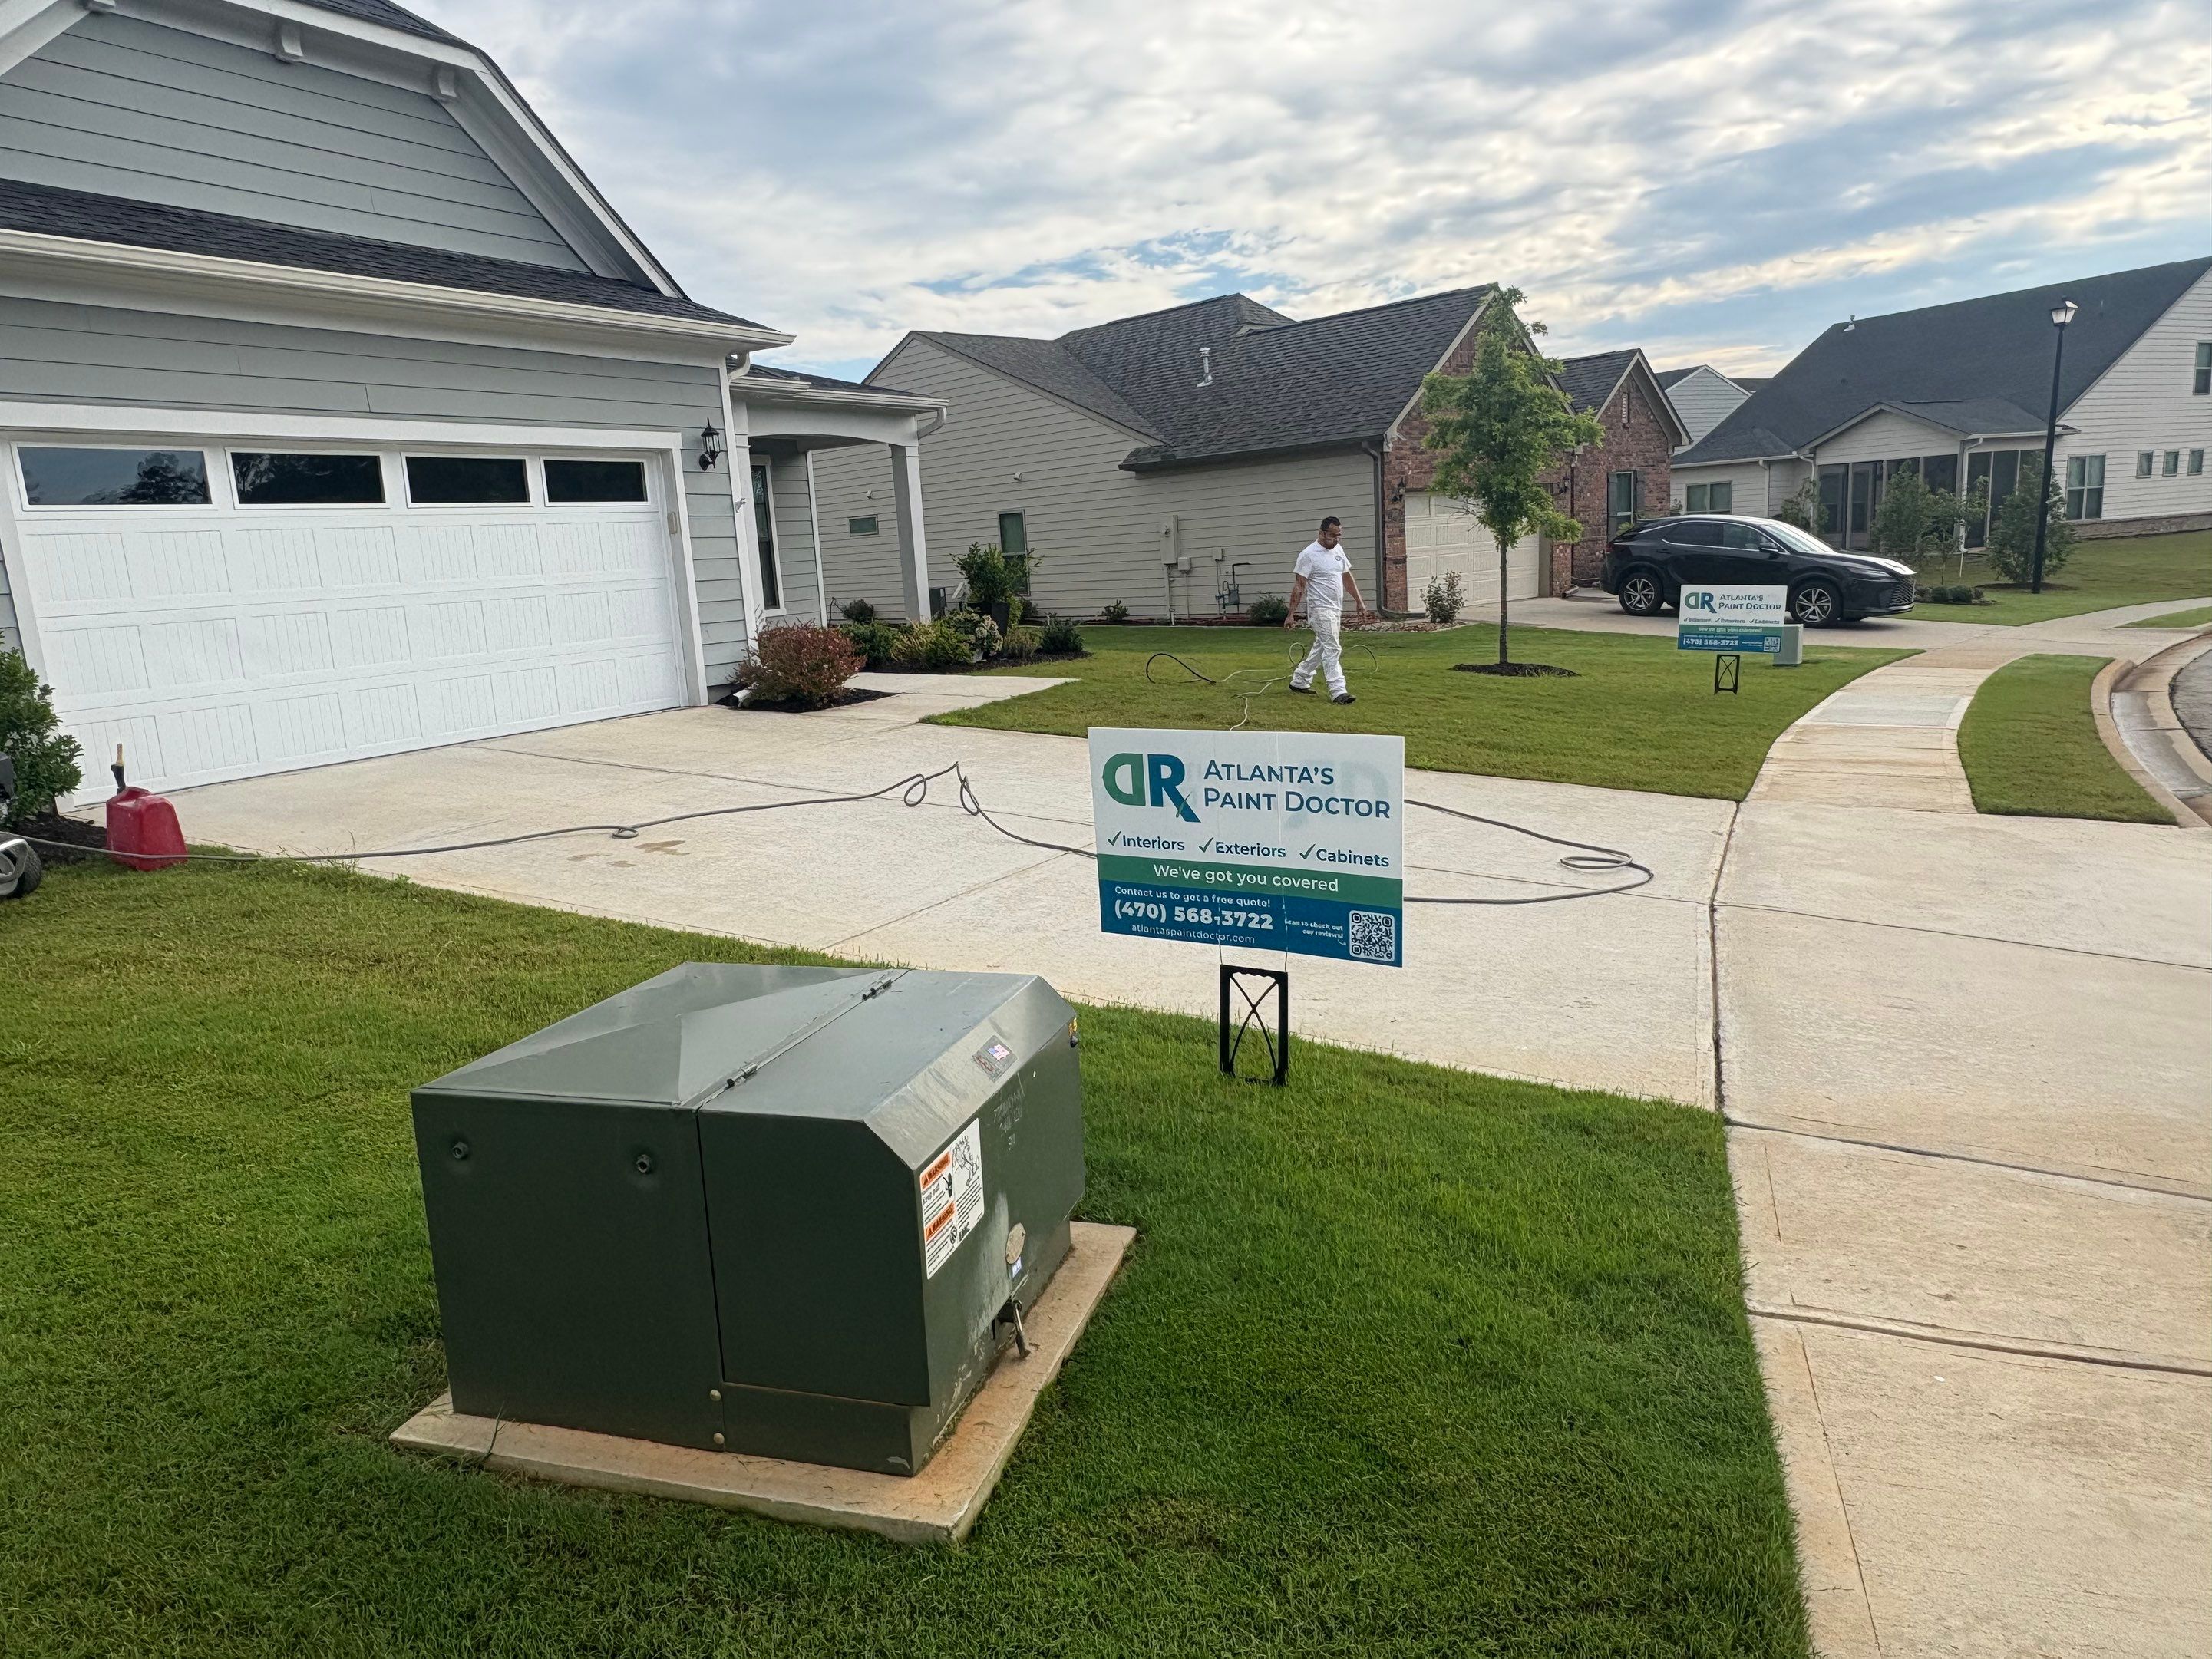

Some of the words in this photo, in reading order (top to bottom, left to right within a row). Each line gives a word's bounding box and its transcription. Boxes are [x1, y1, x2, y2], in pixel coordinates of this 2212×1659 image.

[1203, 760, 1334, 785] ATLANTA'S
[1204, 787, 1276, 810] PAINT
[1285, 790, 1390, 819] DOCTOR
[1123, 835, 1185, 851] Interiors
[1216, 841, 1286, 857] Exteriors
[1316, 848, 1389, 867] Cabinets
[1153, 864, 1200, 880] We've
[1205, 870, 1233, 883] got
[1236, 872, 1267, 886] you
[1272, 876, 1339, 892] covered
[1114, 886, 1153, 897] Contact
[1170, 891, 1180, 900] to
[1183, 894, 1200, 902] get
[1211, 894, 1234, 904] free
[1236, 897, 1271, 909] quote!
[1114, 899, 1167, 923] (470)
[1174, 905, 1273, 930] 568-3722
[1131, 923, 1255, 945] atlantaspaintdoctor.com
